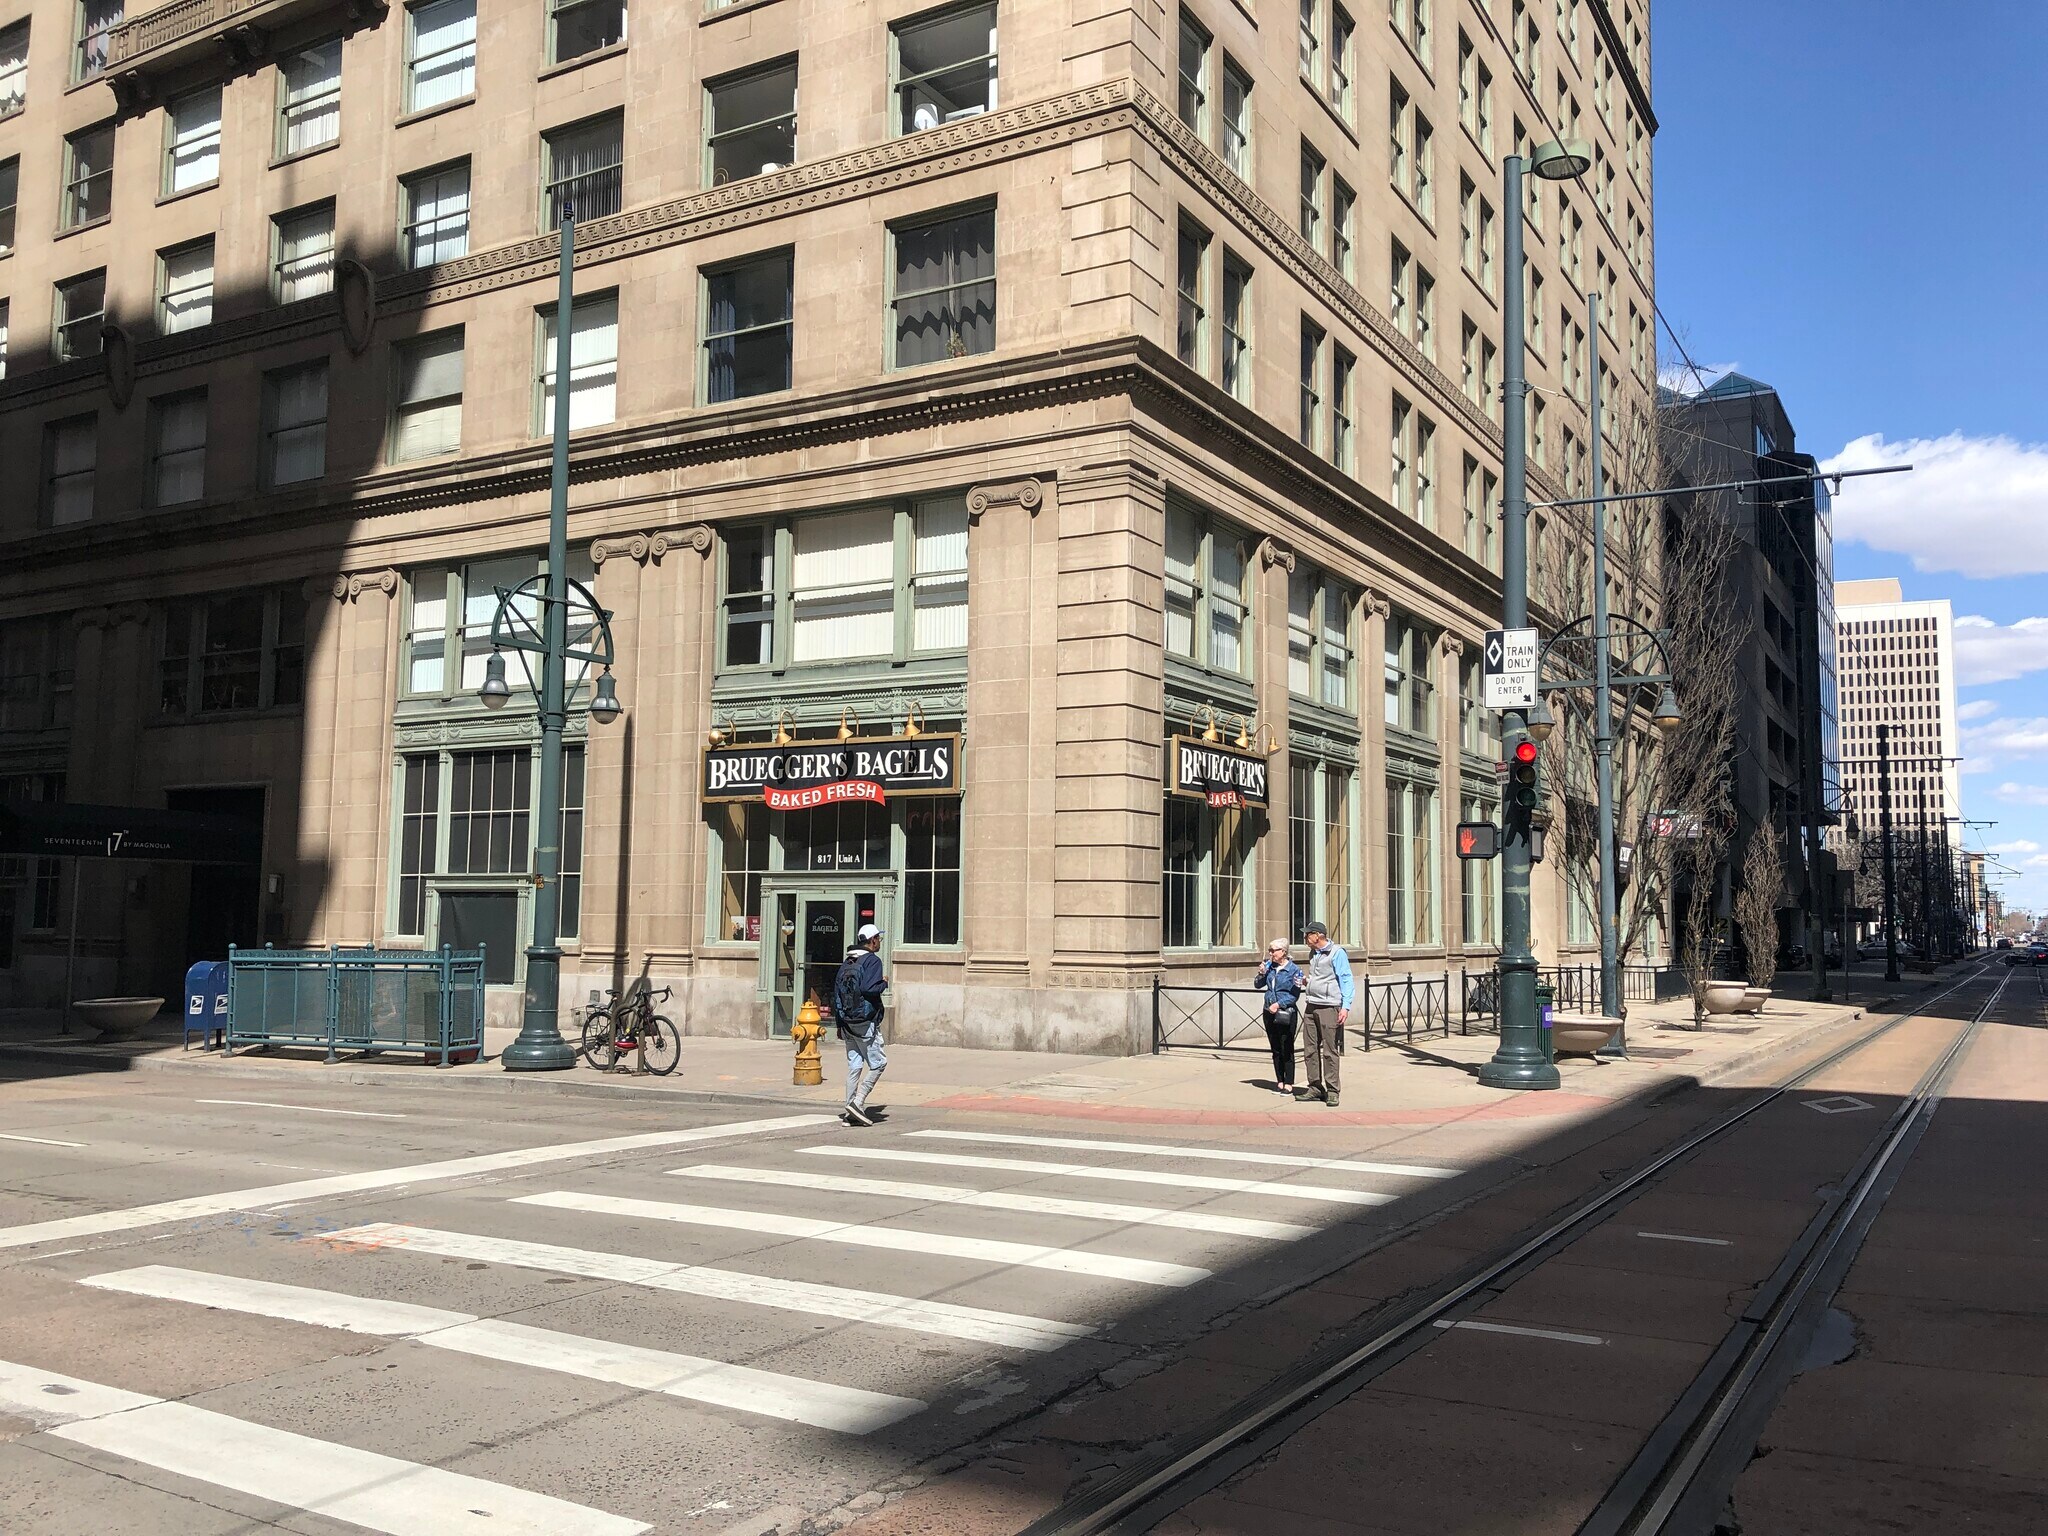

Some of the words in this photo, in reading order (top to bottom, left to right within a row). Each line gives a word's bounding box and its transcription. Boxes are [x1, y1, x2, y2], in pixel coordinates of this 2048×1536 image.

[1506, 646, 1534, 657] TRAIN
[1507, 658, 1531, 668] ONLY
[1495, 677, 1506, 685] DO
[1510, 675, 1525, 684] NOT
[1497, 686, 1523, 695] ENTER
[708, 752, 848, 790] BRUEGGER'S
[855, 746, 949, 780] BAGELS
[1179, 747, 1265, 797] BRUEGGER'S
[770, 789, 822, 807] BAKED
[826, 783, 877, 800] FRESH
[44, 837, 103, 846] SEVENTEENTH
[107, 832, 123, 857] 17
[133, 841, 171, 849] MAGNOLIA
[817, 854, 832, 864] 817
[838, 854, 853, 863] Unit
[854, 854, 861, 863] A
[812, 925, 839, 934] BAGELS
